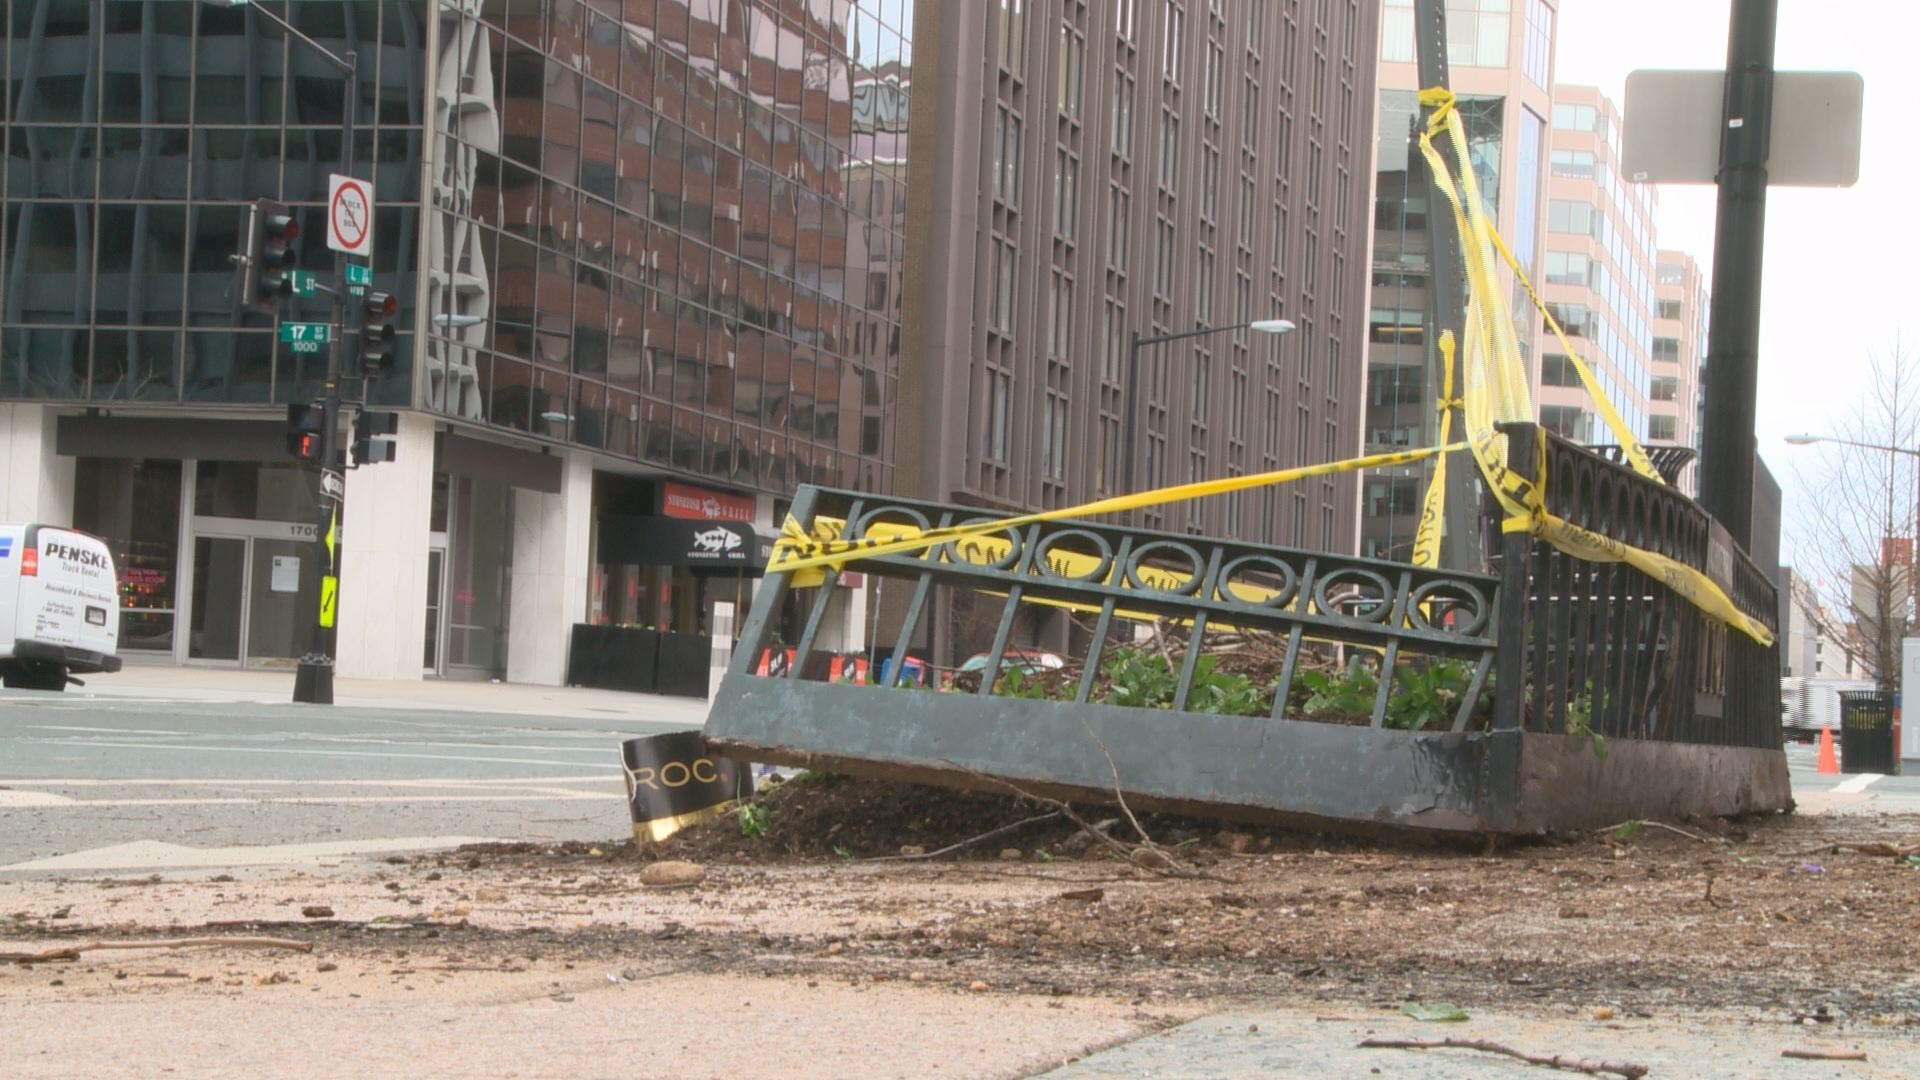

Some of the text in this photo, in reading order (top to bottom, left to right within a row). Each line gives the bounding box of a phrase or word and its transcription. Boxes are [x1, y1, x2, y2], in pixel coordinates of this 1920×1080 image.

[350, 266, 357, 281] L
[292, 270, 315, 293] L ST
[290, 325, 306, 340] 17
[293, 342, 318, 353] 1000
[45, 542, 109, 570] PENSKE
[62, 561, 80, 574] Truck
